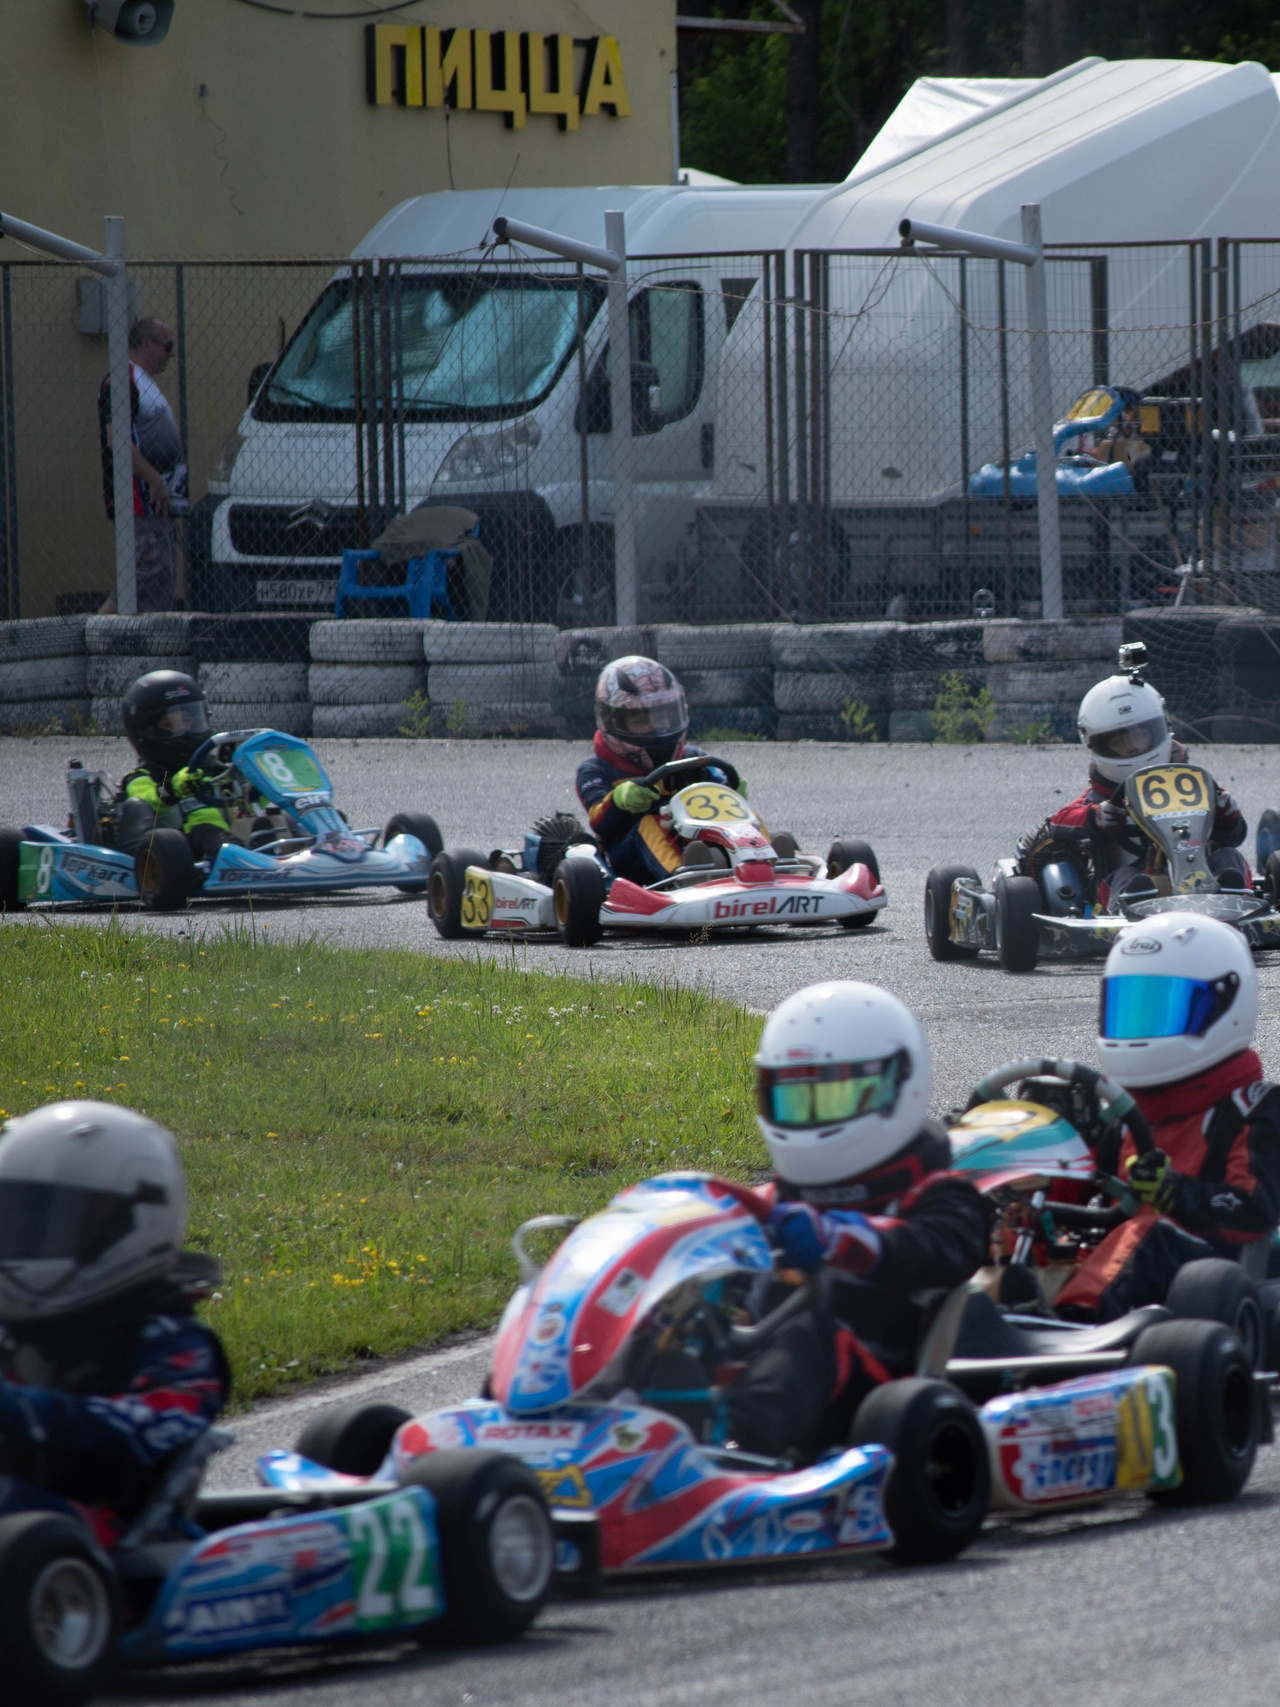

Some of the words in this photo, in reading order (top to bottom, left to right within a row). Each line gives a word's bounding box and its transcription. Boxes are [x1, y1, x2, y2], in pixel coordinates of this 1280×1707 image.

[367, 24, 632, 131] ПИЦЦА
[262, 752, 294, 783] 8
[686, 793, 749, 821] 33
[1142, 772, 1203, 810] 69
[39, 847, 54, 894] 8
[464, 878, 491, 924] 33
[353, 1500, 436, 1617] 22
